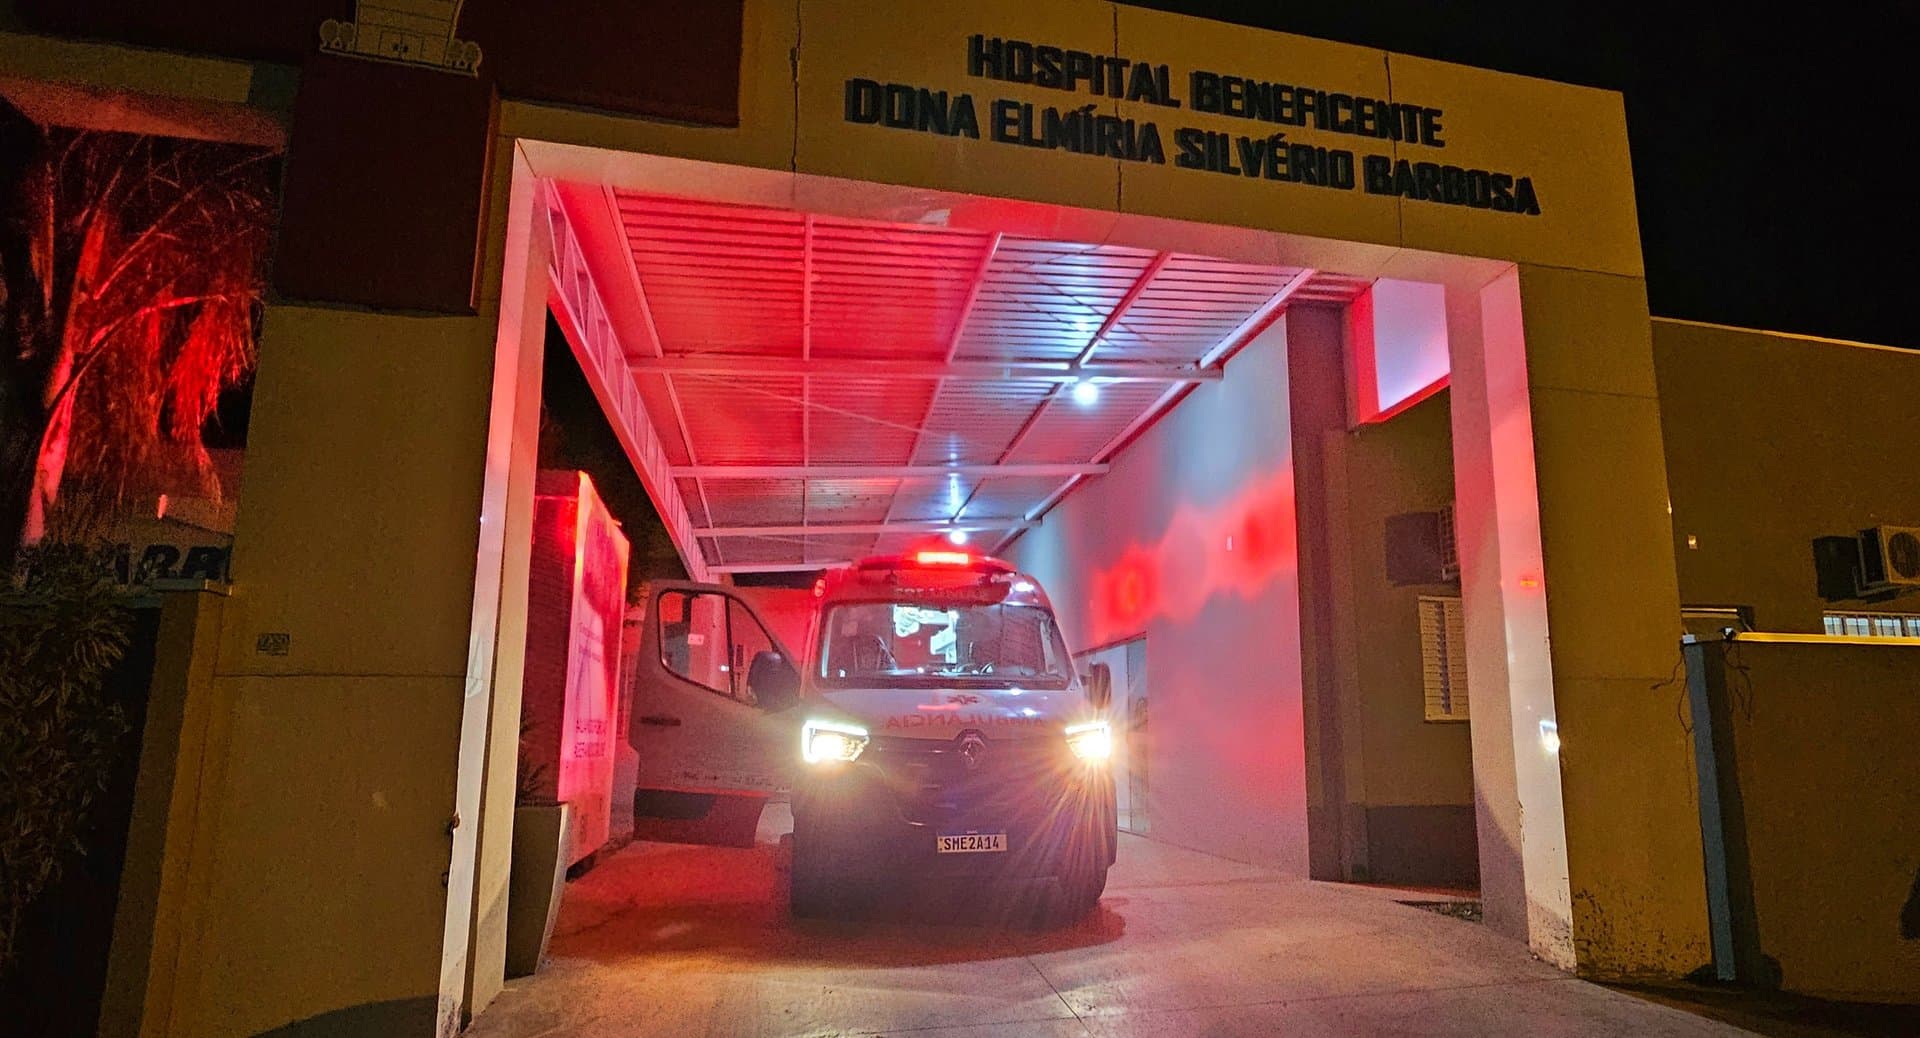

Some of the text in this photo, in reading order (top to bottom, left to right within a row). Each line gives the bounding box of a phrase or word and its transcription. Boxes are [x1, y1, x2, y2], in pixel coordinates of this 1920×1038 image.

[845, 78, 1541, 216] DONA ELMÍRIA SILVÉRIO BARBOSA
[969, 34, 1446, 148] HOSPITAL BENEFICENTE
[944, 836, 999, 851] SHE2A14
